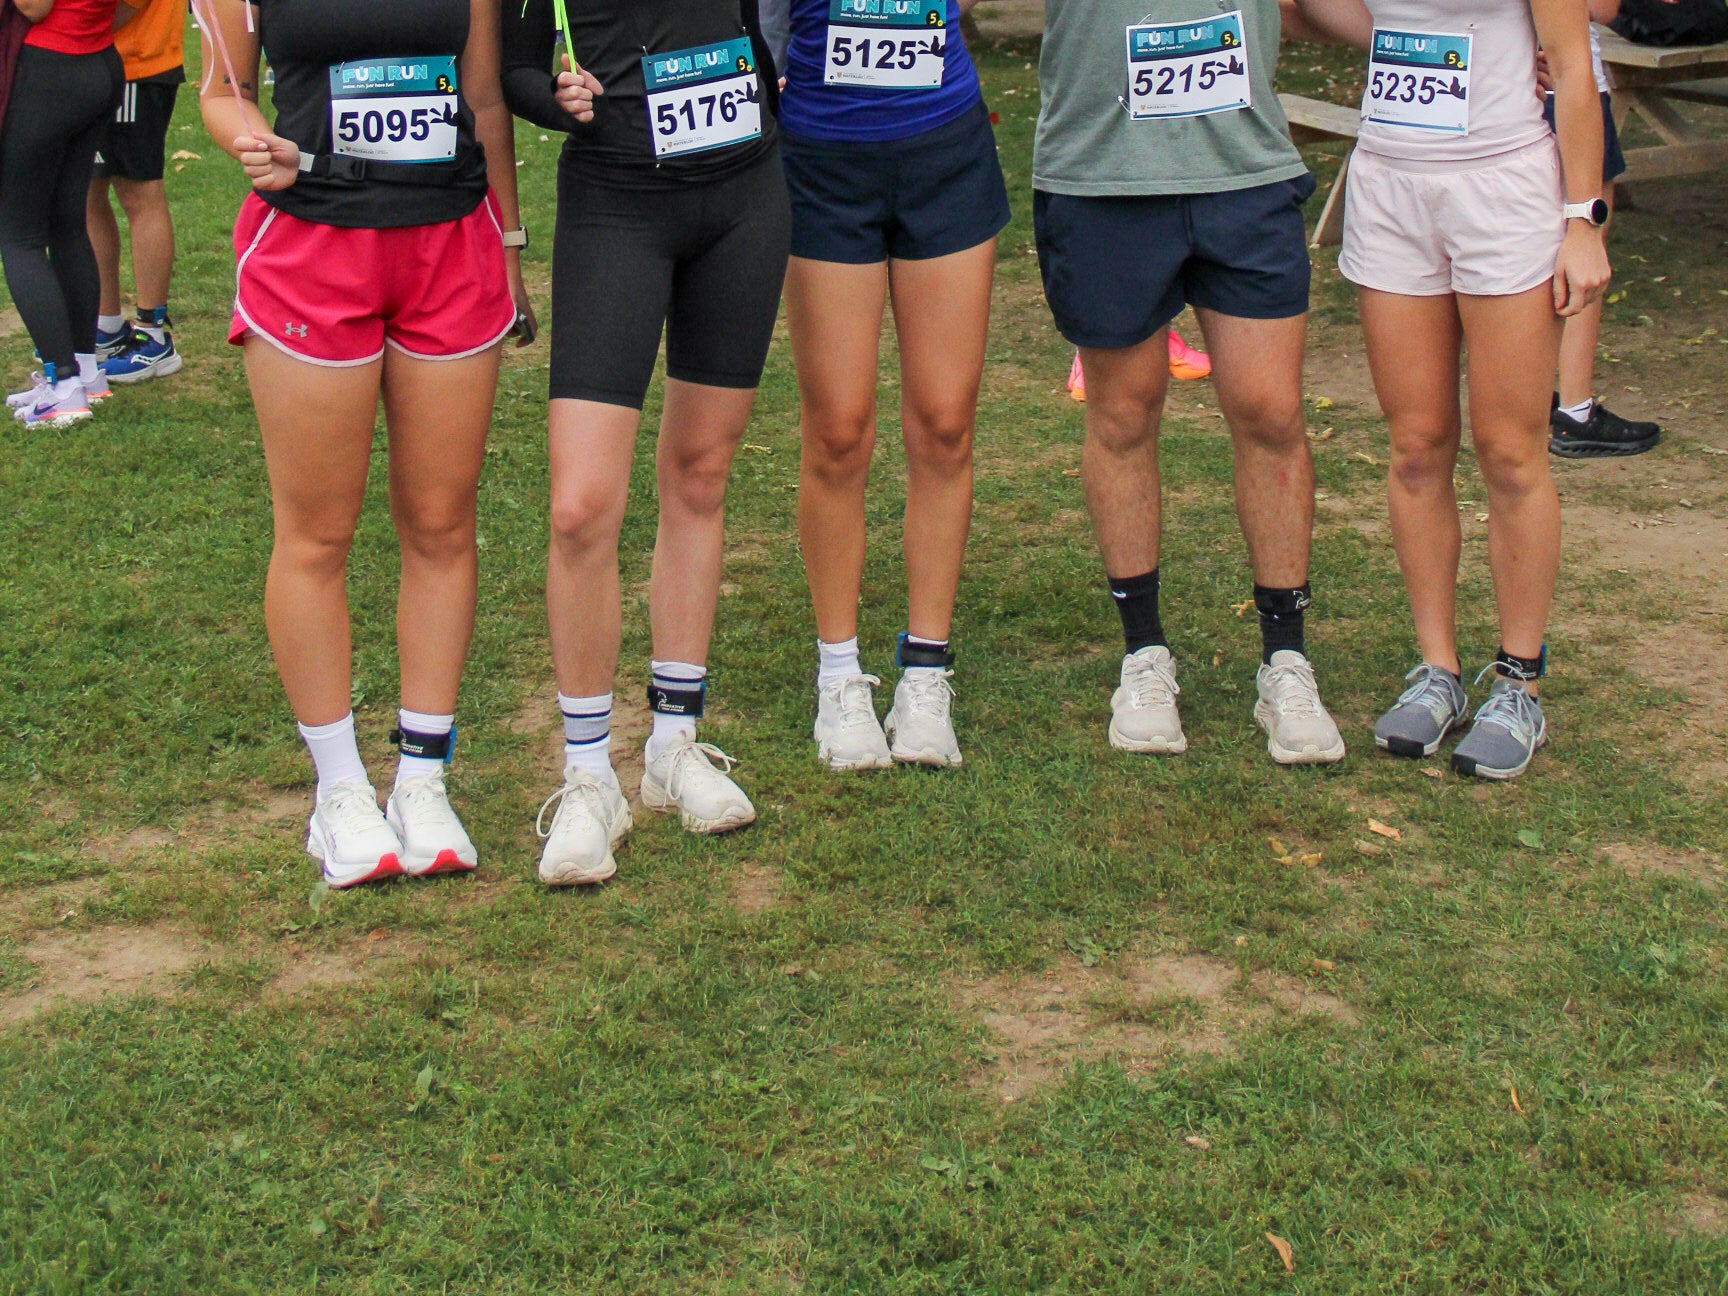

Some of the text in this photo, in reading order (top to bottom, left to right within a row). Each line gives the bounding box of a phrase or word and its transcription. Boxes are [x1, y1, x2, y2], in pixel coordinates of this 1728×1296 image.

[883, 0, 920, 14] RUN
[930, 13, 937, 24] 5
[1137, 31, 1174, 46] FUN
[1178, 25, 1214, 43] RUN
[1224, 34, 1231, 44] 5
[1378, 34, 1402, 50] FUN
[1405, 37, 1437, 53] RUN
[654, 49, 729, 76] FUN RUN
[832, 37, 916, 70] 5125
[1448, 54, 1456, 64] 5
[343, 64, 427, 83] FUN RUN
[739, 58, 746, 70] 5
[439, 78, 447, 90] 5
[1134, 61, 1216, 96] 5215
[1371, 71, 1436, 104] 5235
[658, 91, 737, 135] 5176
[339, 109, 429, 143] 5095
